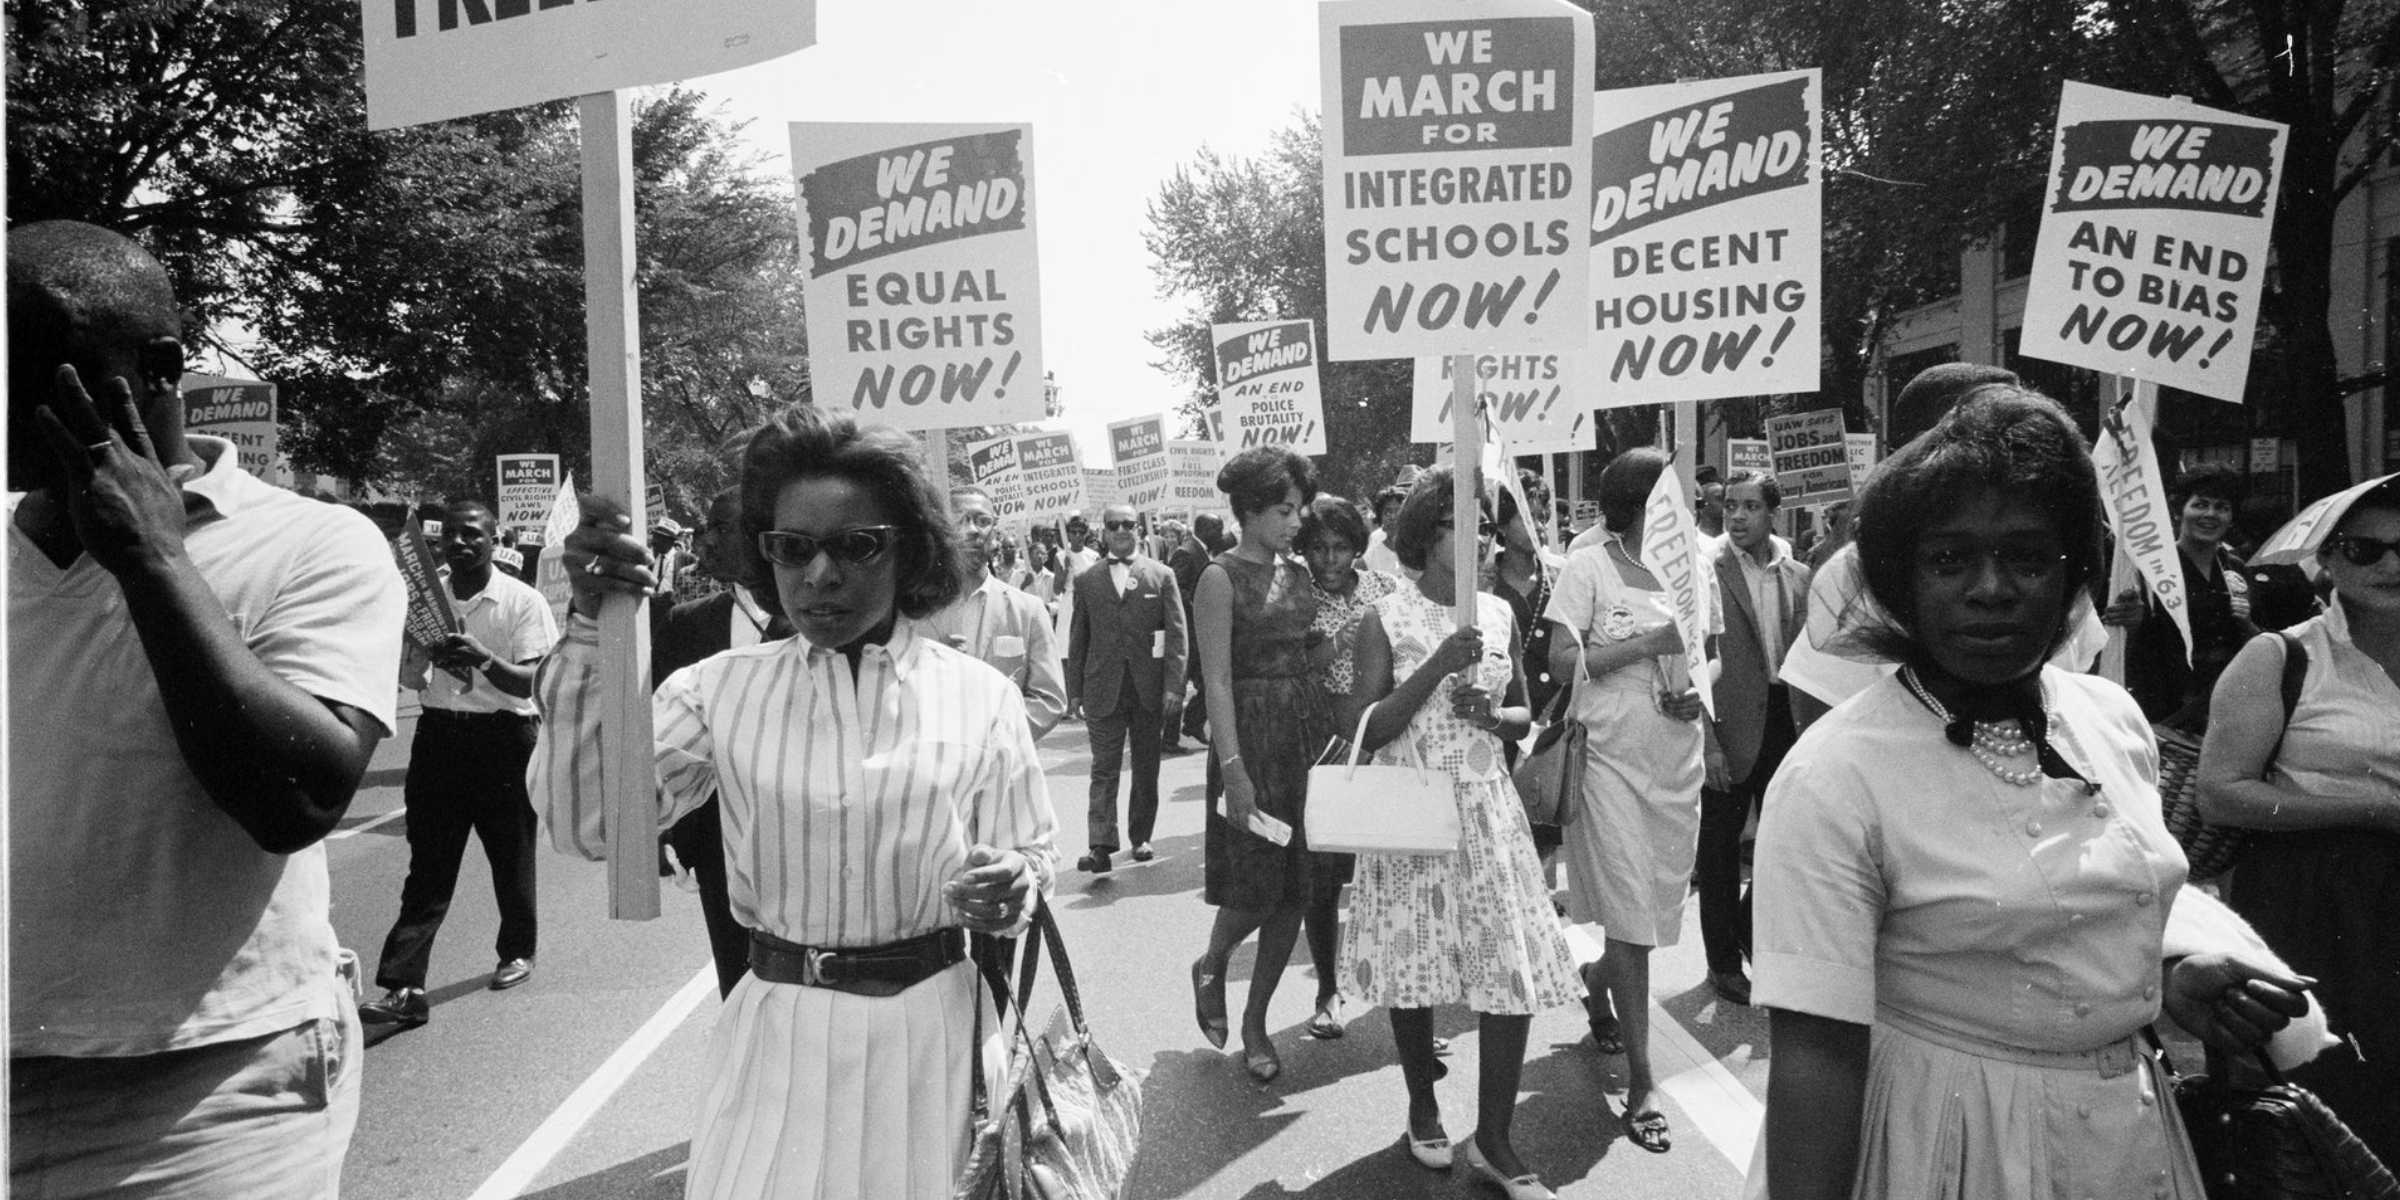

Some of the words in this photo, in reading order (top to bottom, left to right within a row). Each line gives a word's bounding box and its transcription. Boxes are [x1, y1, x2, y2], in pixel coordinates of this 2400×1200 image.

[1424, 29, 1492, 66] WE
[1359, 69, 1556, 119] MARCH
[1422, 122, 1498, 145] FOR
[1649, 101, 1734, 164] WE
[2130, 124, 2212, 161] WE
[876, 145, 954, 199] WE
[1591, 130, 1801, 233] DEMAND
[2068, 163, 2263, 204] DEMAND
[1344, 162, 1573, 209] INTEGRATED
[824, 178, 1018, 260] DEMAND
[1346, 219, 1570, 265] SCHOOLS
[1613, 228, 1789, 278] DECENT
[2068, 220, 2137, 260] AN
[2153, 234, 2248, 282] END
[846, 269, 1007, 307] EQUAL
[2068, 259, 2125, 298] TO
[2138, 273, 2239, 323] BIAS
[1363, 267, 1561, 335] NOW!
[1596, 280, 1806, 331] HOUSING
[847, 312, 1014, 353] RIGHTS
[1248, 328, 1281, 354] WE
[2059, 303, 2233, 369] NOW!
[1226, 341, 1307, 382] DEMAND
[1609, 315, 1796, 383] NOW!
[851, 350, 1022, 410] NOW!
[1441, 355, 1559, 380] GHTS
[212, 387, 245, 404] WE
[1235, 383, 1263, 397] AN
[1268, 381, 1304, 394] END
[190, 401, 269, 424] DEMAND
[1251, 399, 1295, 413] POLICE
[1130, 425, 1144, 436] WE
[1240, 412, 1304, 427] BRUTALITY
[1774, 420, 1804, 432] UAW
[1807, 415, 1835, 427] SAYS
[1035, 438, 1053, 448] WE
[1118, 432, 1159, 453] MARCH
[1241, 419, 1315, 449] NOW!
[1774, 430, 1820, 451] JOBS
[1822, 431, 1842, 444] and
[989, 441, 1010, 459] WE
[1023, 445, 1069, 462] MARCH
[1039, 458, 1057, 466] FOR
[1734, 453, 1770, 462] MARCH
[1776, 448, 1845, 473] FREEDOM
[505, 468, 551, 479] MARCH
[978, 453, 1016, 478] DEMA
[1022, 465, 1077, 483] INTEGRATED
[1118, 462, 1141, 477] FIRST
[1142, 456, 1167, 471] CLASS
[1182, 461, 1201, 470] FULL
[984, 477, 1001, 487] AN
[1005, 473, 1020, 483] EN
[995, 484, 1022, 495] POLICE
[1026, 478, 1080, 496] SCHOOLS
[1118, 468, 1169, 490] CITIZENSHIP
[1806, 478, 1849, 494] American
[524, 494, 556, 502] RIGHTS
[1034, 490, 1080, 511] NOW!
[1128, 483, 1168, 506] NOW!
[1174, 486, 1214, 498] REEDOM
[1645, 494, 1696, 624] FREEDOM
[2149, 558, 2165, 576] IN
[399, 531, 427, 582] MARCH
[423, 587, 450, 637] WASHINGT
[2155, 574, 2183, 611] '63
[418, 606, 447, 645] FREEDO
